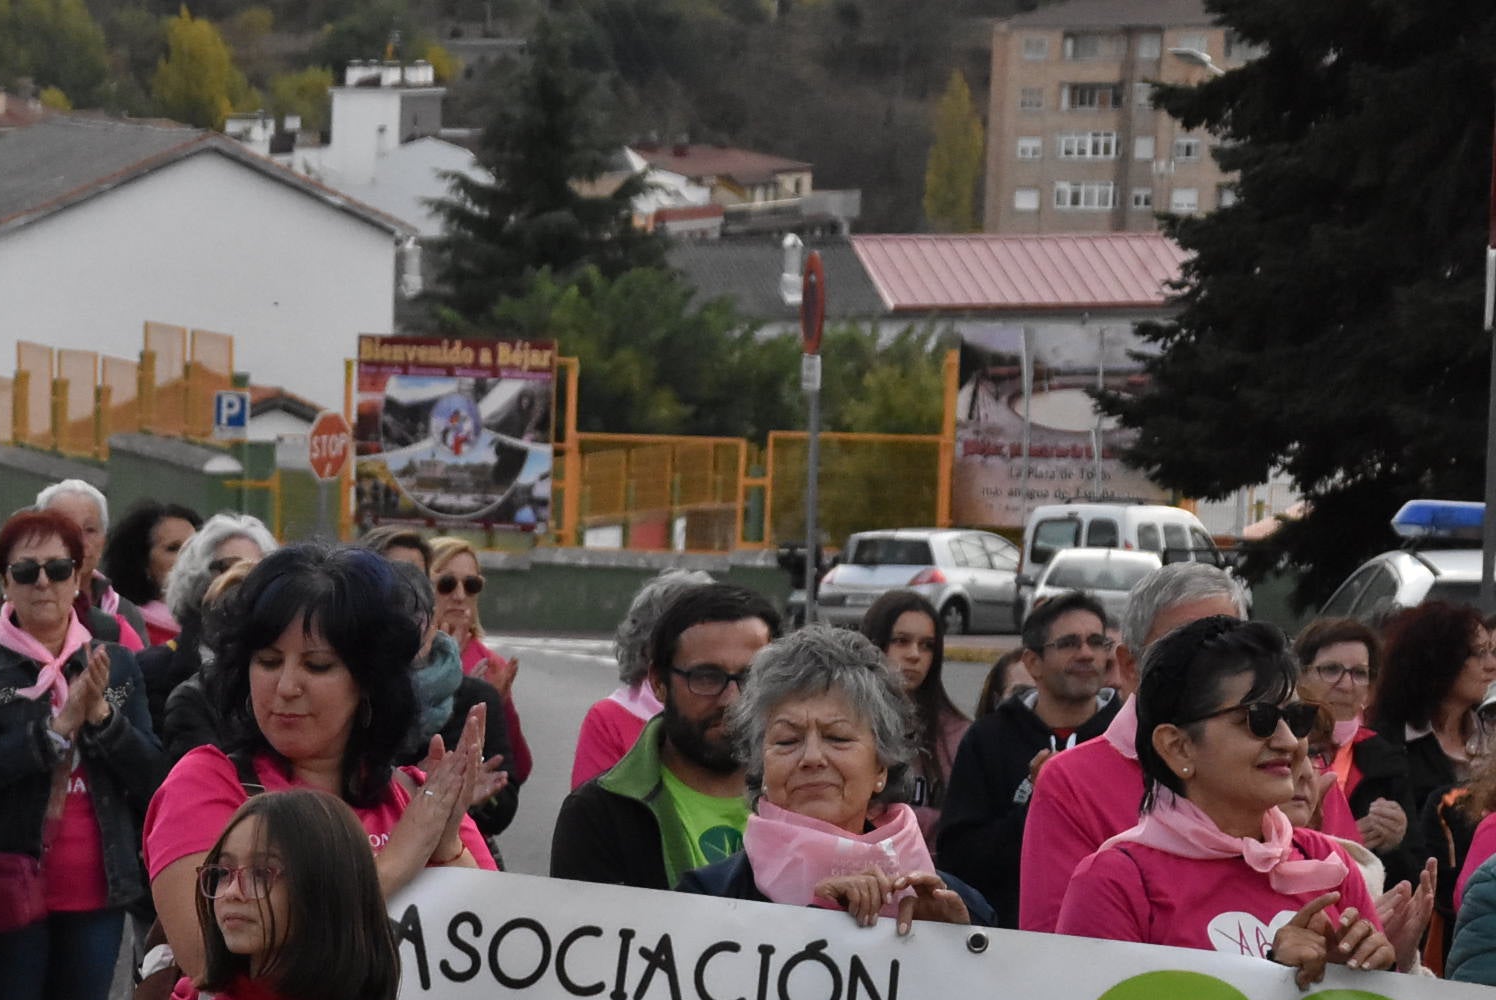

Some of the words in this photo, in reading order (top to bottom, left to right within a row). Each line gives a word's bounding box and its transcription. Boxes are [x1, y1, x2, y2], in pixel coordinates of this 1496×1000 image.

[360, 338, 474, 365] Bienvenido
[497, 339, 552, 371] Béjar
[220, 393, 241, 426] P
[311, 433, 347, 459] STOP
